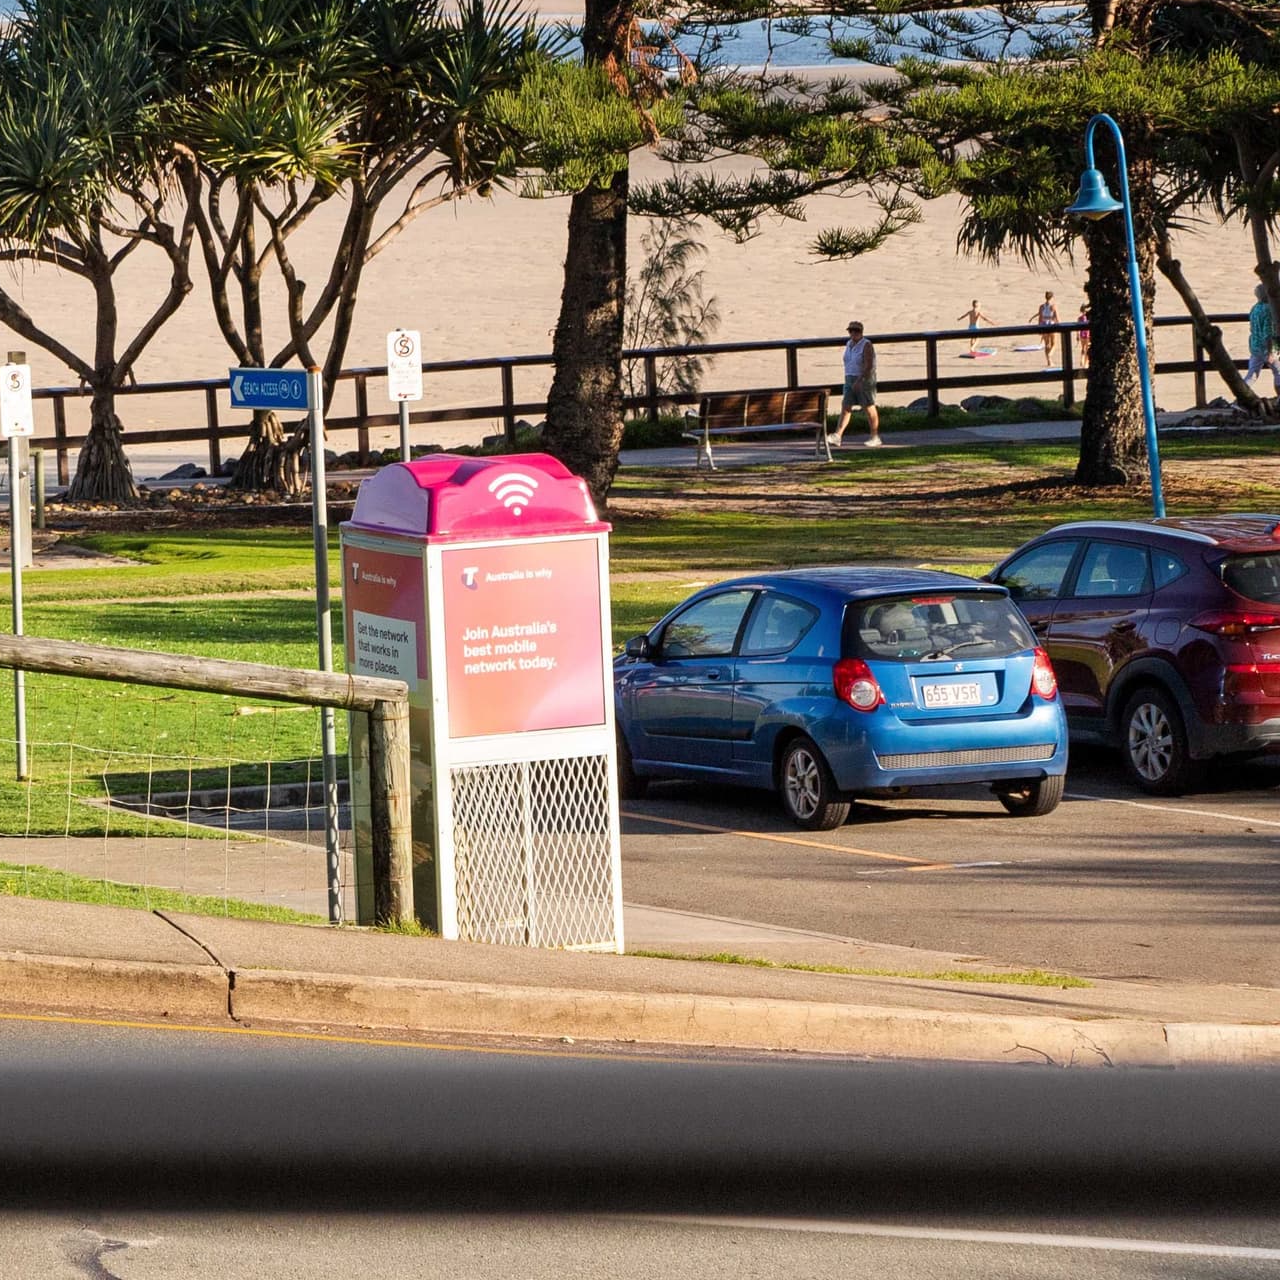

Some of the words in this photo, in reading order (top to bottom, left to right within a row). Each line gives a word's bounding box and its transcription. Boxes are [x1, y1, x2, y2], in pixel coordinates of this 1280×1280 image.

[244, 382, 259, 395] BEACH
[261, 382, 278, 395] ACCESS
[362, 571, 381, 583] Australia
[386, 576, 397, 588] why
[486, 571, 525, 582] Australia
[526, 570, 534, 579] is
[535, 568, 552, 579] why
[358, 622, 368, 636] Get
[368, 624, 379, 638] the
[379, 628, 409, 644] network
[463, 627, 488, 640] Join
[492, 621, 557, 637] Australia's
[358, 639, 371, 653] that
[371, 643, 391, 657] works
[392, 646, 400, 658] in
[464, 644, 491, 657] best
[495, 640, 536, 654] mobile
[359, 657, 374, 670] more
[374, 659, 400, 675] places.
[464, 658, 517, 674] network
[519, 656, 557, 670] today.
